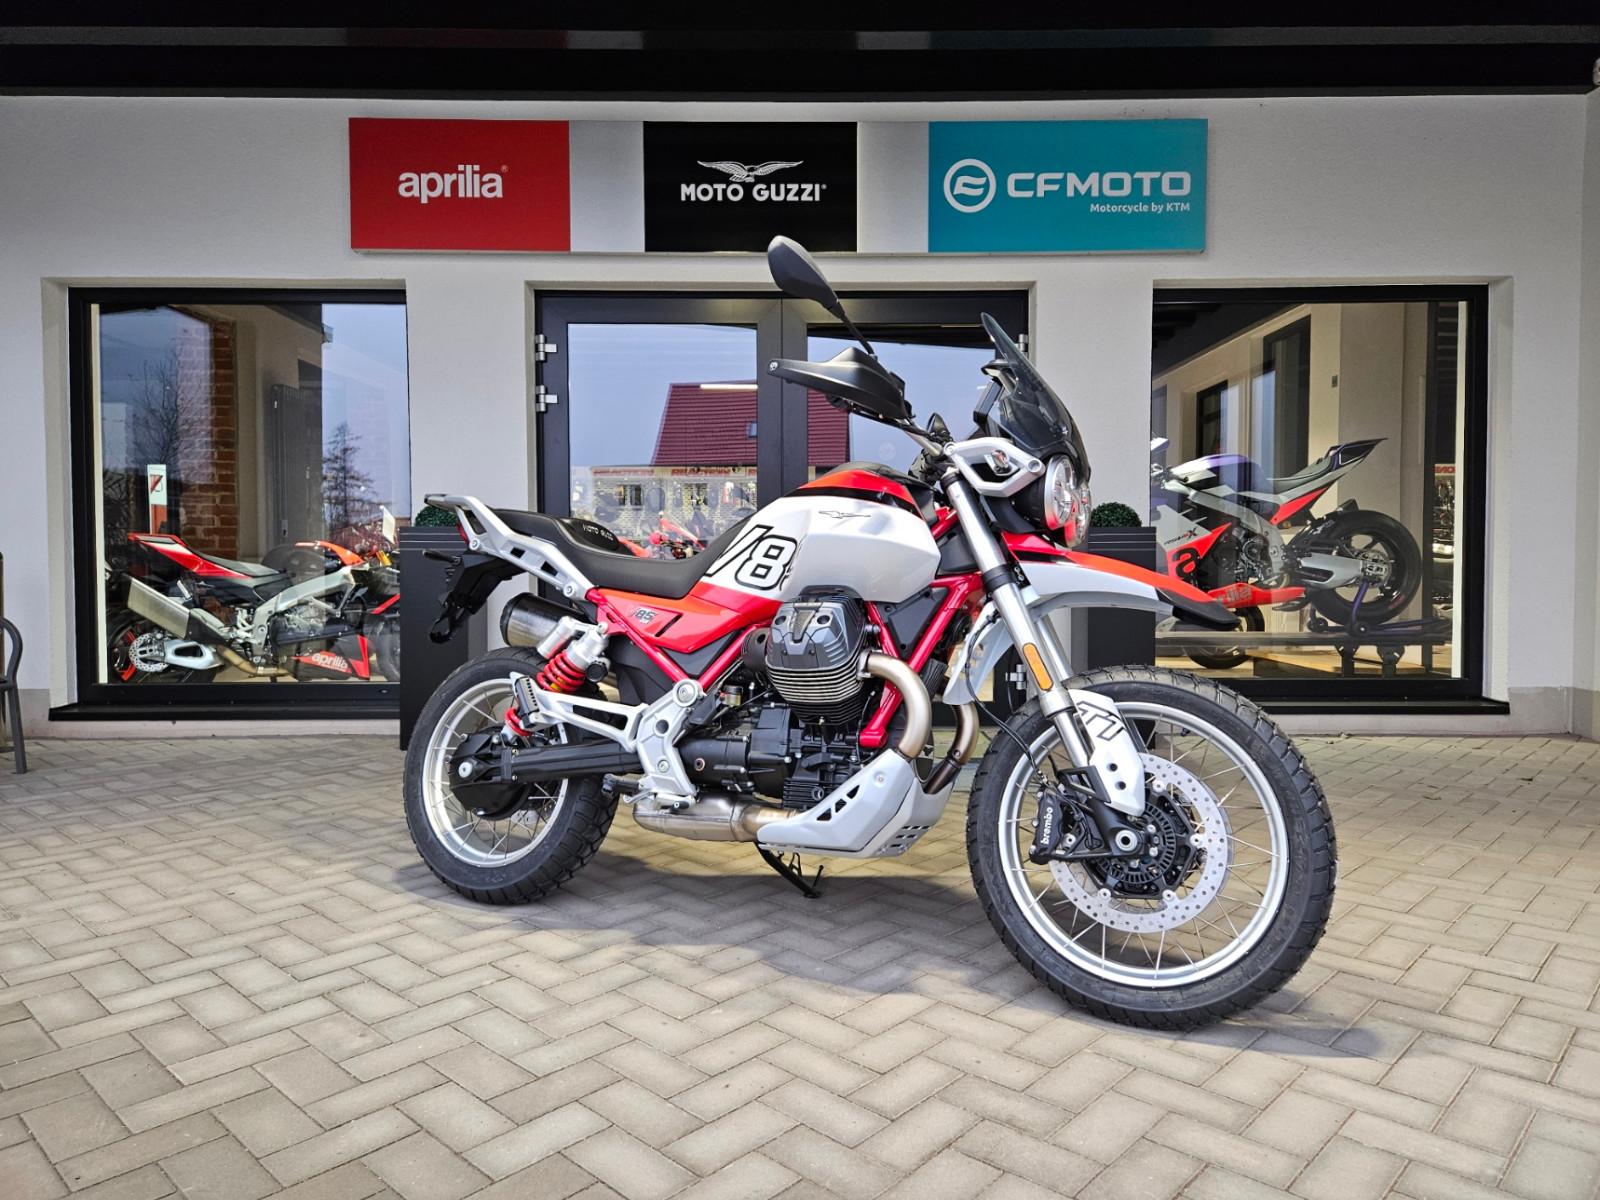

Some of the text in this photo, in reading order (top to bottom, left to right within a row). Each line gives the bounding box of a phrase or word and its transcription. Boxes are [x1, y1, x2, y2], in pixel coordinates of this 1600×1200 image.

[398, 164, 503, 204] aprilia
[680, 183, 821, 201] MOTO GUZZI
[1007, 171, 1191, 198] CFMOTO
[1090, 202, 1190, 214] Motorcycle by KTM
[1040, 806, 1053, 845] brembo
